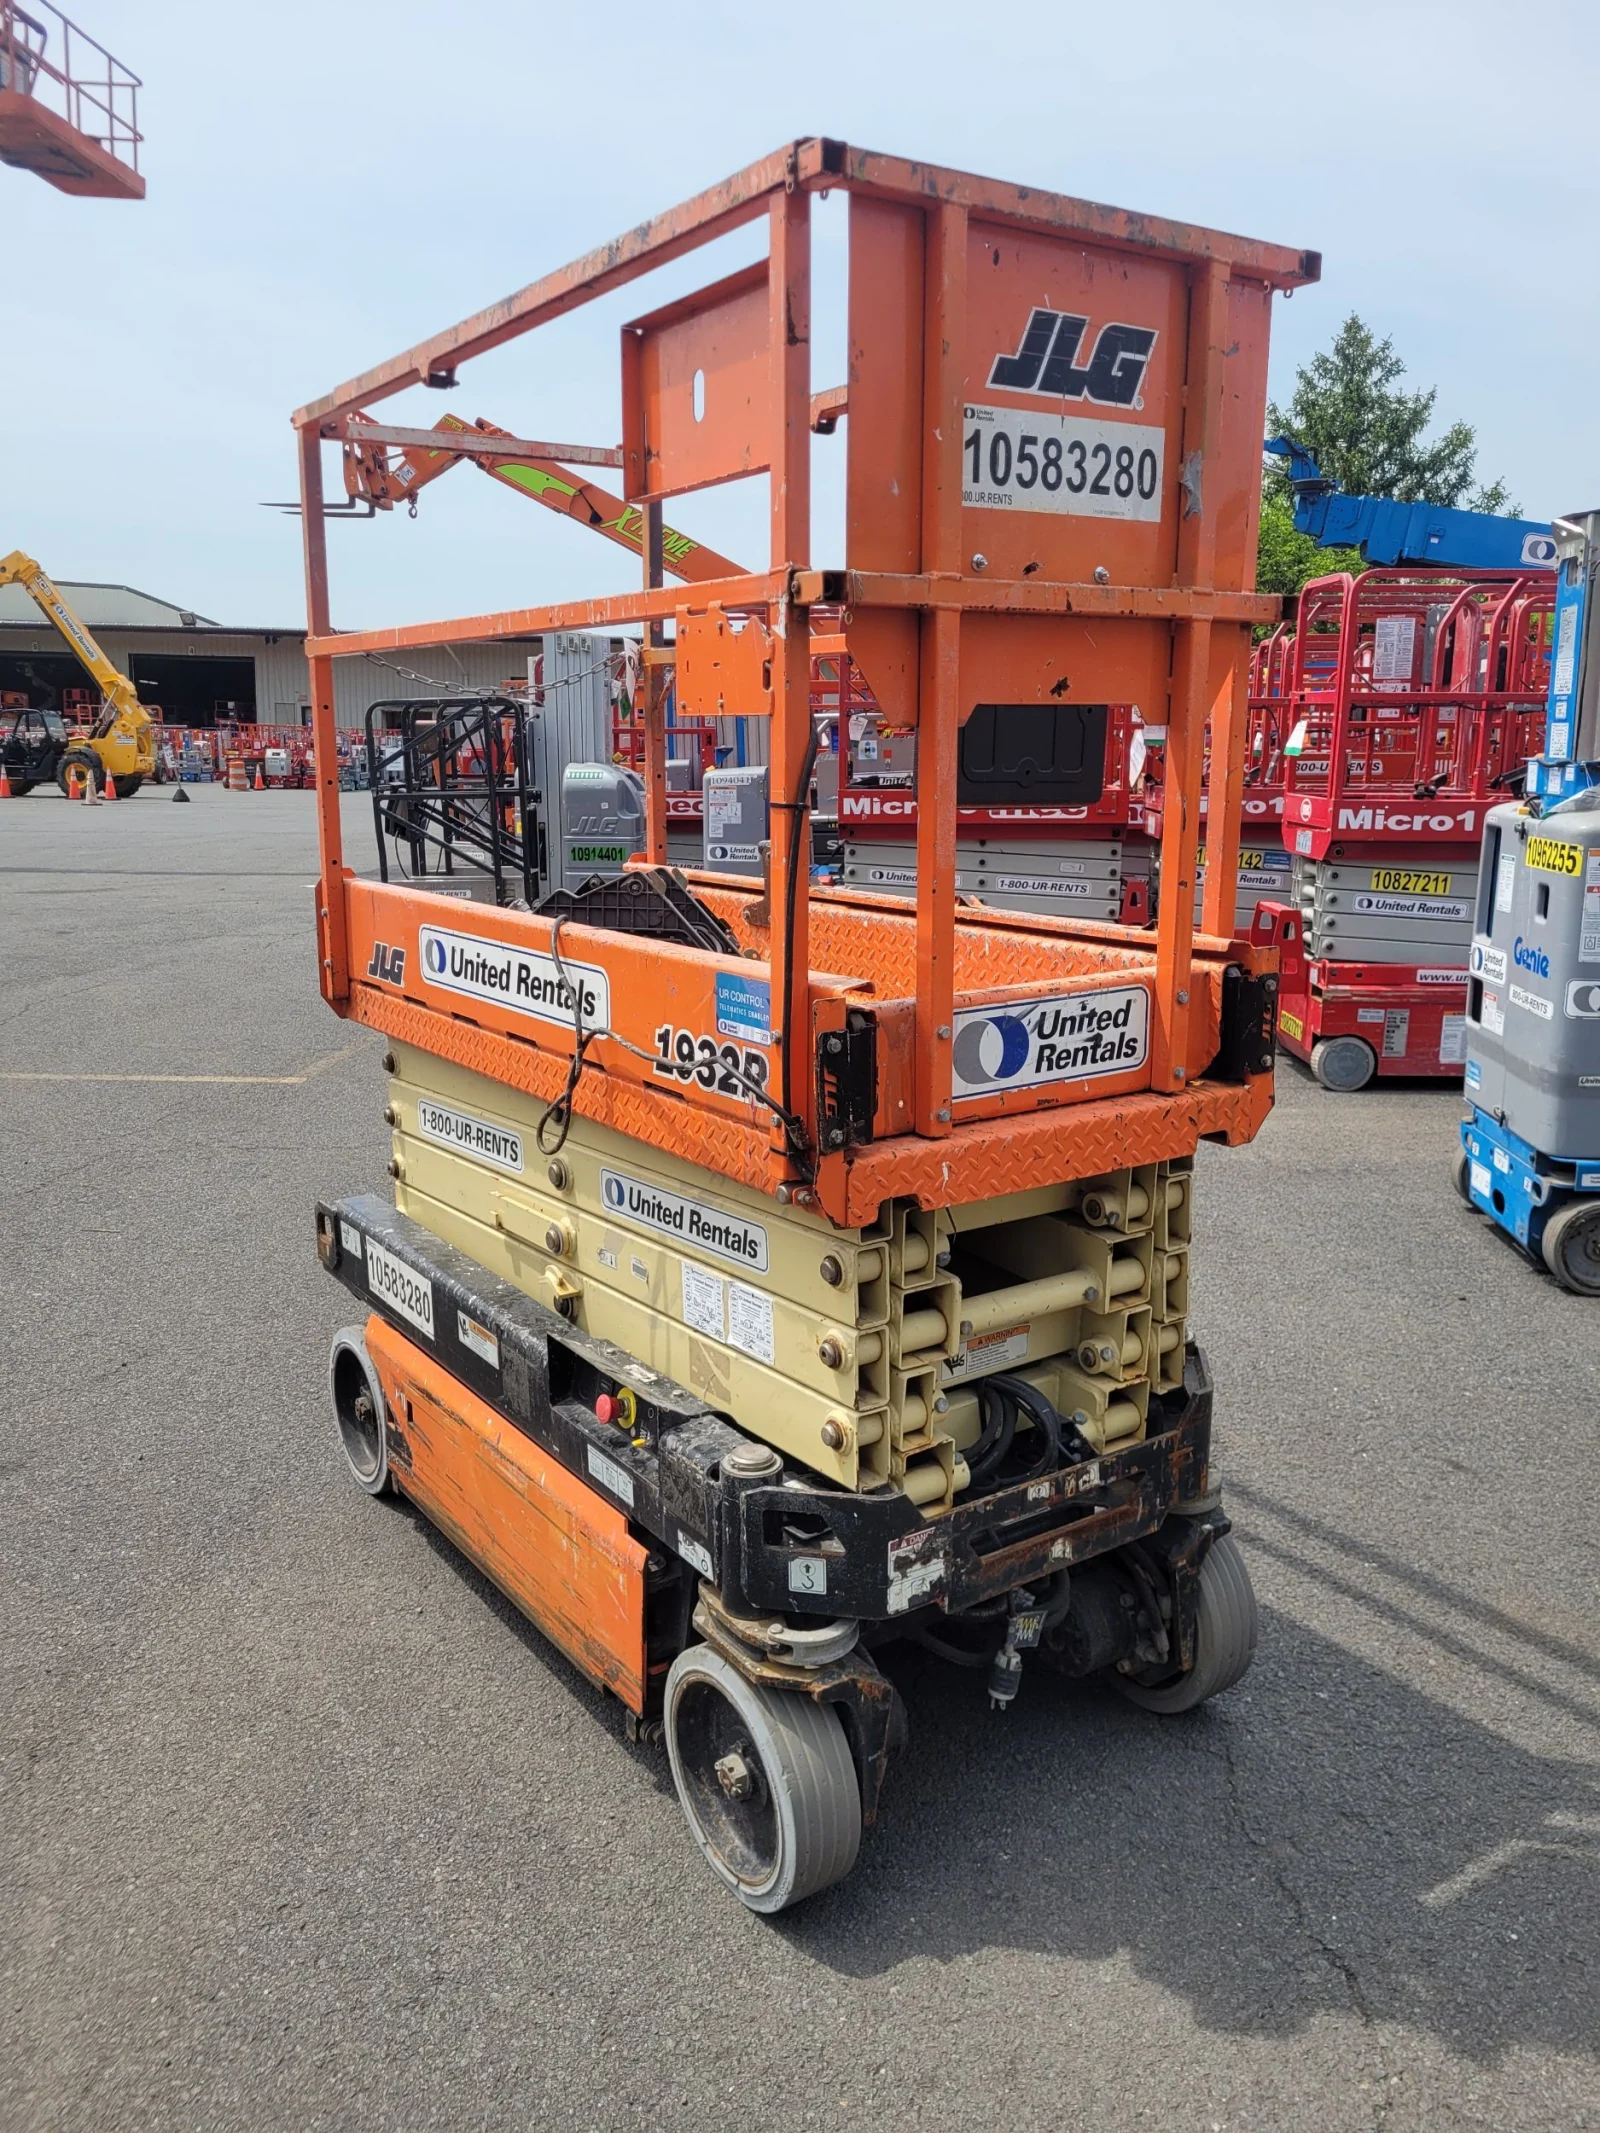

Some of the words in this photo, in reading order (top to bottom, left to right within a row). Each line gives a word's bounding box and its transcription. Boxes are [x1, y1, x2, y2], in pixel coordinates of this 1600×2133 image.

[986, 307, 1159, 409] JLG
[964, 428, 1157, 500] 10583280
[570, 816, 619, 834] JLG
[570, 847, 624, 861] 10914401
[730, 846, 756, 854] United
[730, 853, 758, 861] Rentals
[1527, 838, 1578, 874] 10962255
[1000, 879, 1088, 894] 1-800-UR-RENTS
[1239, 874, 1277, 885] Rentals
[1374, 871, 1449, 893] 10827211
[1375, 900, 1414, 912] United
[1417, 903, 1461, 916] Rentals
[367, 940, 407, 988] JLG
[1484, 950, 1503, 967] United
[1514, 936, 1550, 979] Genie
[451, 946, 511, 992] United
[516, 962, 596, 1017] Rentals
[1483, 966, 1504, 981] Rentals
[719, 987, 730, 1000] UR
[730, 990, 765, 1009] CONTROL
[719, 1003, 747, 1017] TELEMATICS
[1037, 999, 1133, 1041] United
[1034, 1032, 1138, 1074] Rentals
[654, 1025, 769, 1108] 1932R
[422, 1107, 519, 1163] 1-800-UR-RENTS
[628, 1186, 684, 1231] United
[688, 1208, 759, 1260] Rentals
[368, 1250, 431, 1324] 10583280
[984, 1327, 1019, 1343] WARNING
